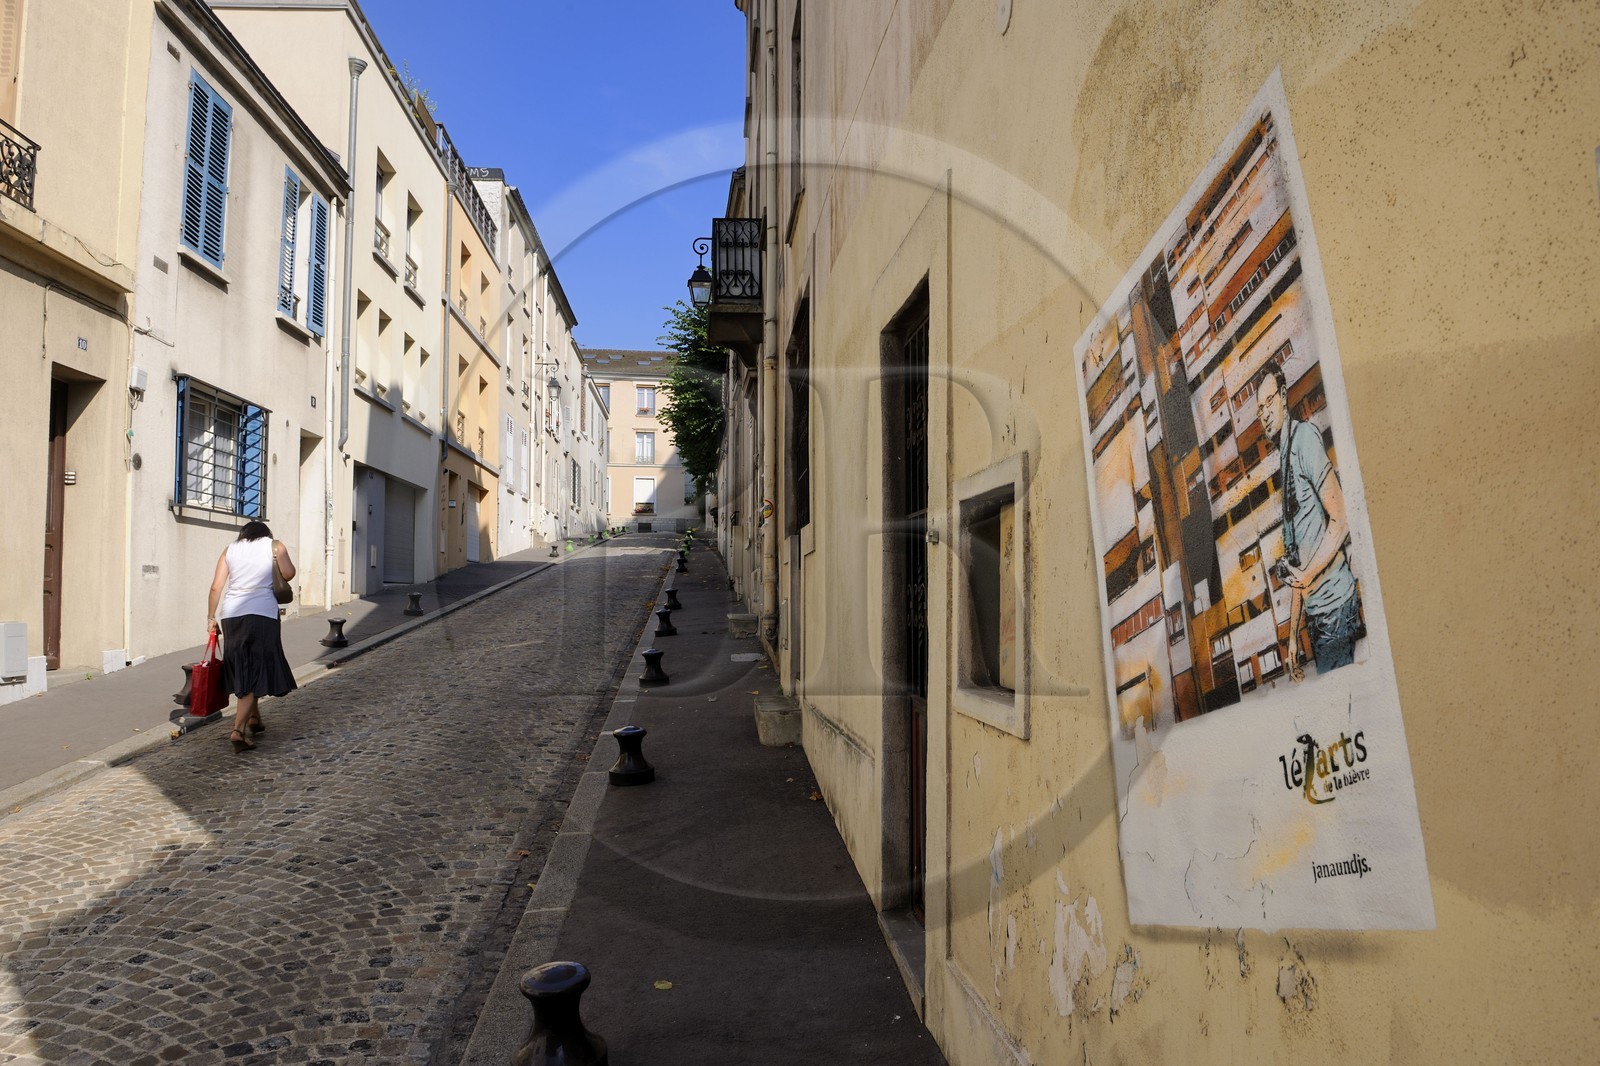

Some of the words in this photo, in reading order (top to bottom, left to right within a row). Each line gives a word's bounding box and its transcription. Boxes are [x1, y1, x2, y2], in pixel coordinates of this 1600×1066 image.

[1323, 778, 1333, 792] de
[1333, 776, 1343, 791] la
[1343, 768, 1370, 787] bièvre
